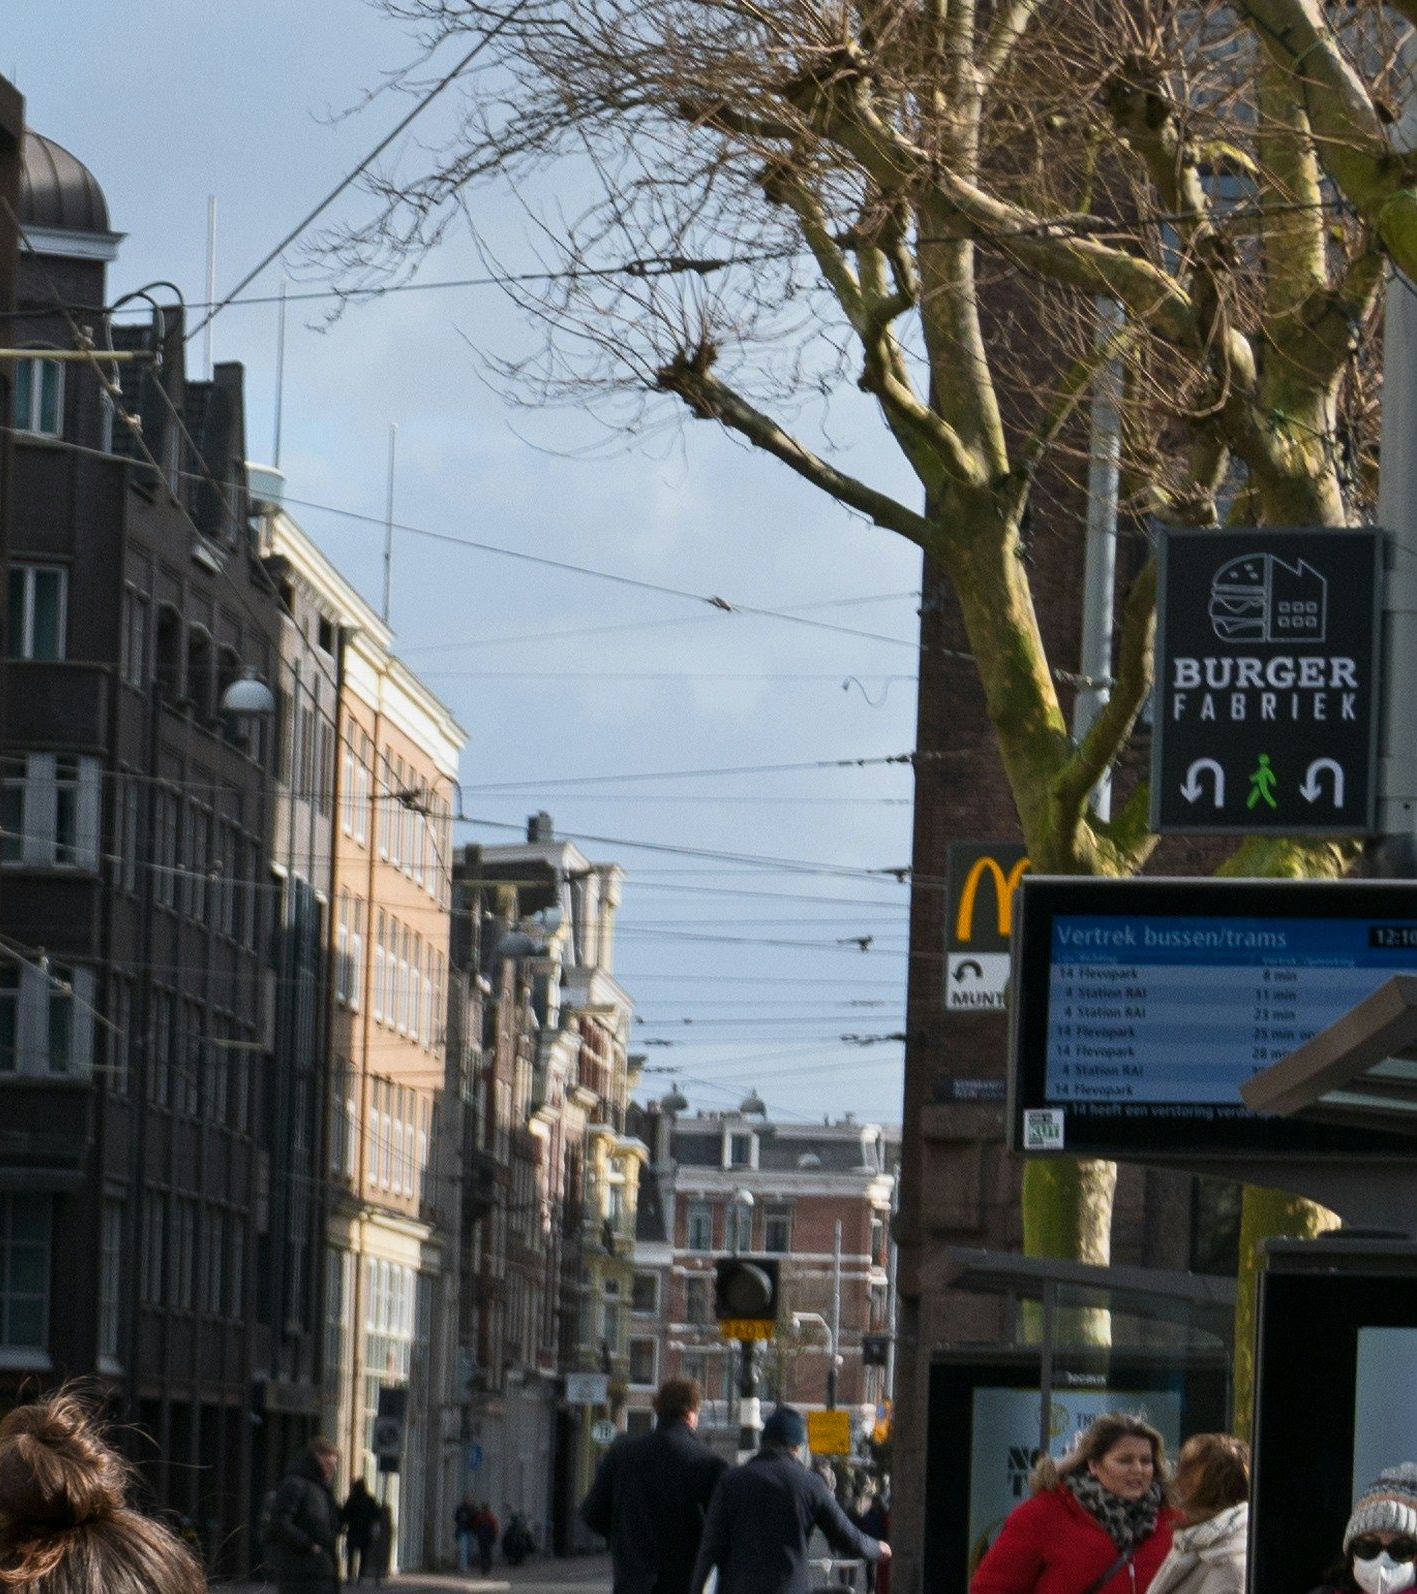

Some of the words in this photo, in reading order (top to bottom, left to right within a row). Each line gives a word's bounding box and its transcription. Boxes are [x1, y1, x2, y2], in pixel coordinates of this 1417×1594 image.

[1173, 656, 1358, 690] BURGER
[1173, 693, 1357, 721] FABRIEK
[1058, 925, 1136, 946] Vertrek
[1144, 926, 1287, 948] bussen/trams
[1078, 967, 1138, 982] Flevopark
[1274, 970, 1298, 982] min
[1078, 986, 1121, 1000] Station
[1273, 989, 1297, 1002] min
[1077, 1006, 1121, 1019] Station
[1272, 1009, 1296, 1021] min
[1076, 1025, 1135, 1040] Flevopark
[1271, 1028, 1295, 1040] min
[1076, 1044, 1134, 1059] Flevopark
[1074, 1064, 1119, 1077] Station
[1074, 1083, 1133, 1099] Flevopark
[1151, 1107, 1214, 1121] verstoring
